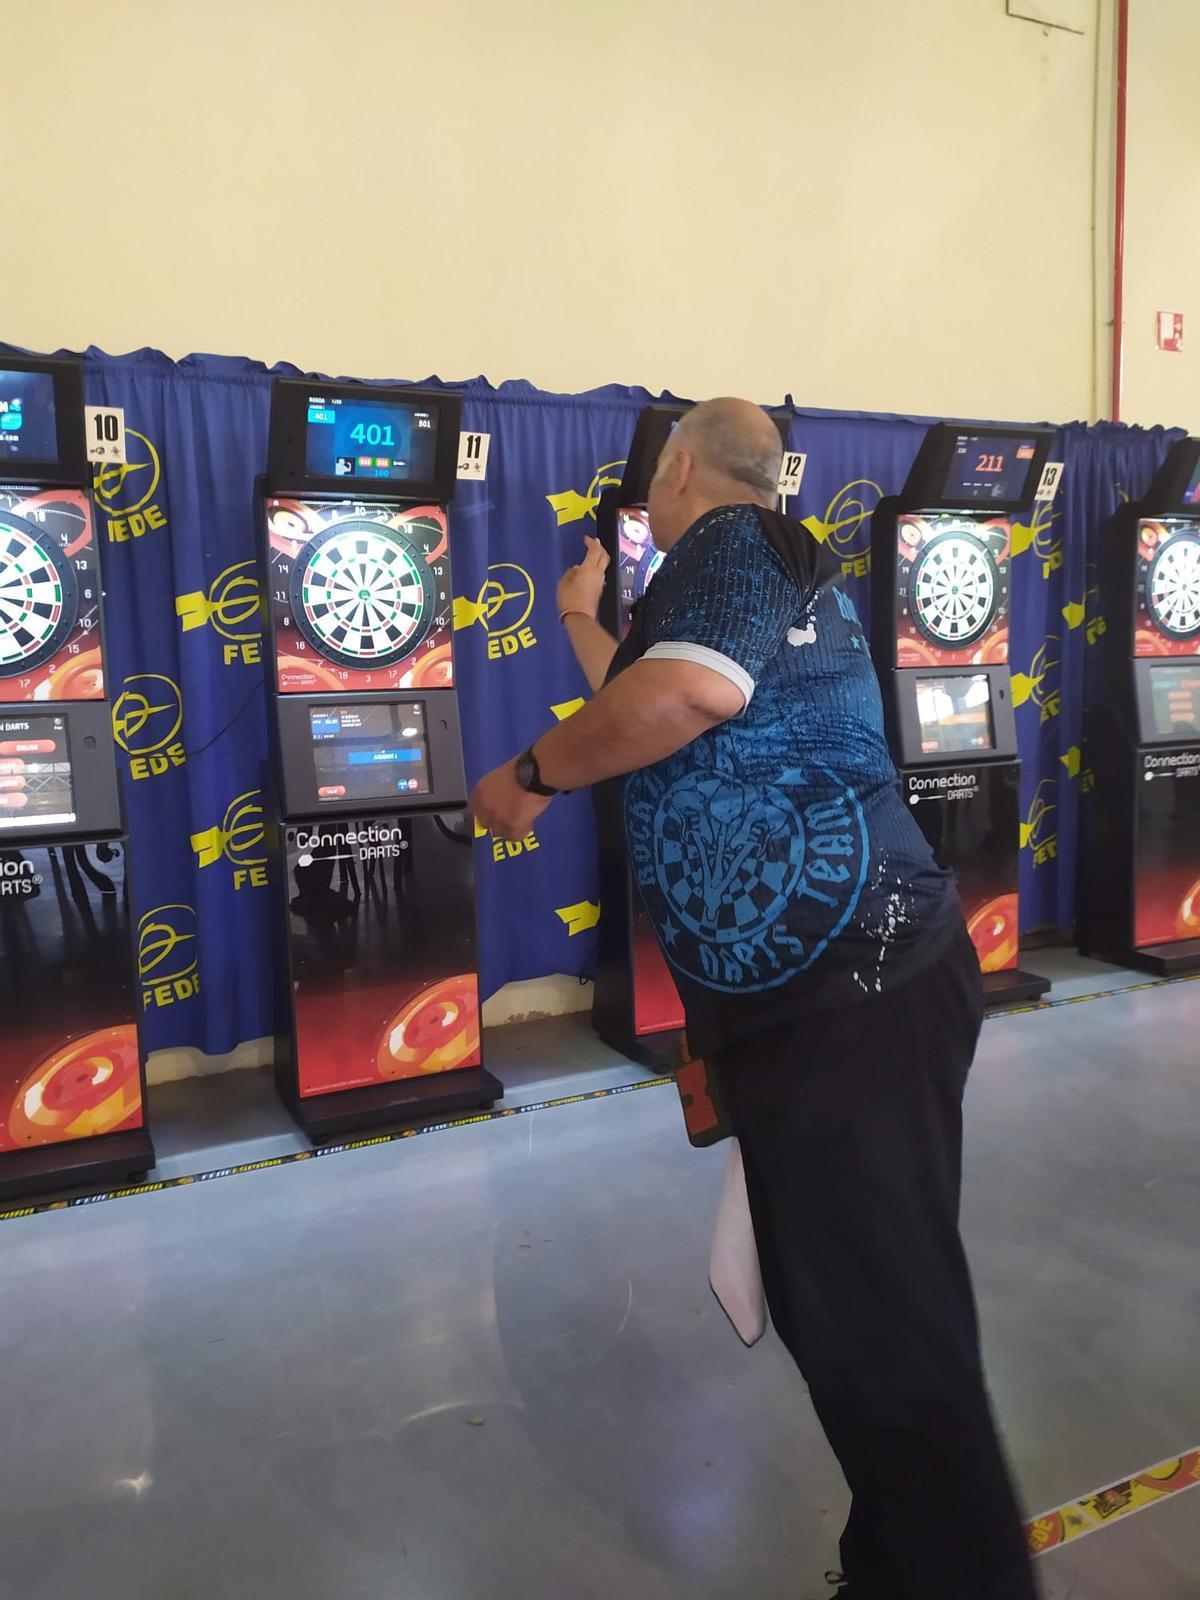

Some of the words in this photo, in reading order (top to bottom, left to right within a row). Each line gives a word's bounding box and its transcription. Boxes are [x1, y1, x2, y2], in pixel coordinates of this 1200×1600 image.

[94, 414, 119, 441] 10
[350, 423, 395, 446] 401
[466, 435, 482, 459] 11
[785, 455, 802, 477] 12
[975, 454, 1005, 472] 211
[1042, 467, 1058, 486] 13
[75, 560, 88, 570] 13
[278, 564, 289, 574] 14
[434, 566, 443, 575] 13
[626, 565, 635, 575] 14
[84, 589, 92, 599] 6
[80, 617, 92, 628] 10
[435, 617, 445, 626] 10
[67, 643, 80, 654] 15
[487, 626, 537, 660] EDE
[223, 643, 262, 665] FE
[5, 722, 30, 732] DARTS
[129, 742, 187, 780] EDE
[908, 772, 977, 791] Connection
[296, 825, 402, 849] Connection
[494, 831, 540, 862] EDE
[233, 866, 268, 891] FE
